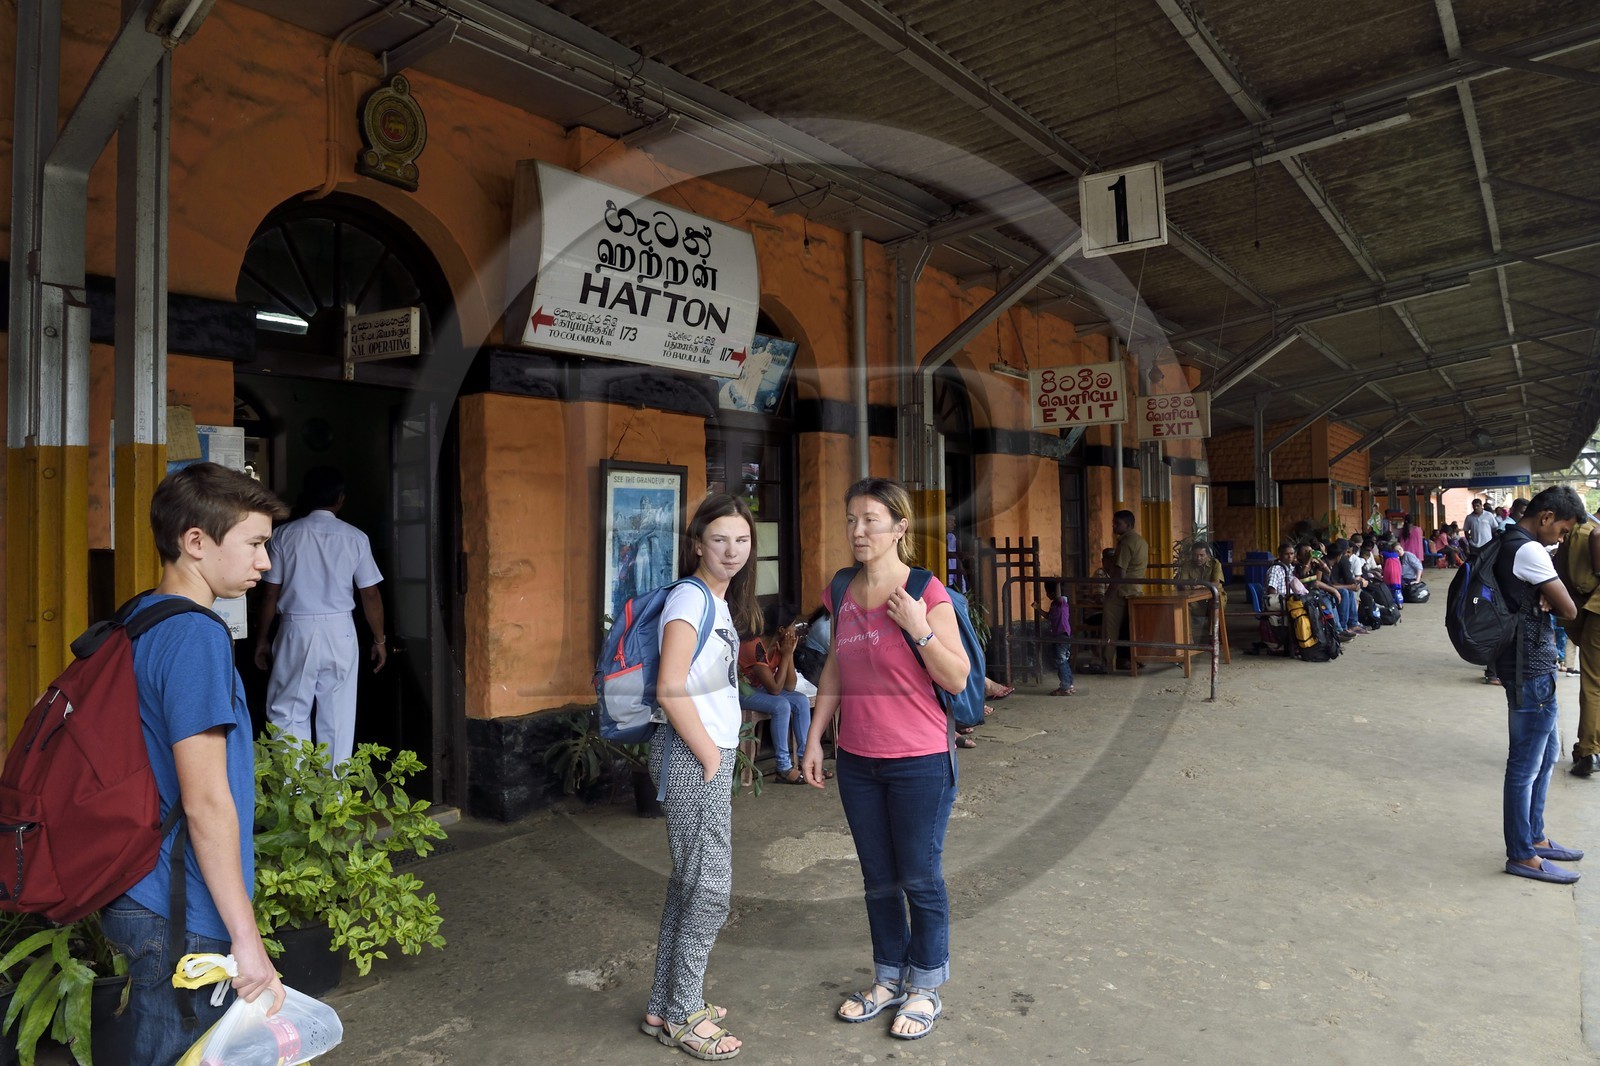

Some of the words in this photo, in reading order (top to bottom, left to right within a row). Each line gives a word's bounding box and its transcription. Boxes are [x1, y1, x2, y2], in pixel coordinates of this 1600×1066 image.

[1106, 173, 1131, 244] 1
[578, 272, 731, 334] HATTON
[549, 329, 560, 338] TO
[560, 331, 600, 344] COLOMBO
[619, 326, 639, 342] 173
[368, 337, 410, 355] OPERATING
[662, 350, 672, 358] TO
[719, 347, 735, 362] 117
[1040, 368, 1113, 394] පිටවීම
[1037, 390, 1118, 408] வெளியே
[1042, 403, 1114, 423] EXIT
[1145, 408, 1200, 423] வெளியே
[1152, 421, 1194, 437] EXIT
[613, 475, 624, 483] SEE
[625, 476, 635, 484] THE
[636, 476, 665, 485] GRANDEUR
